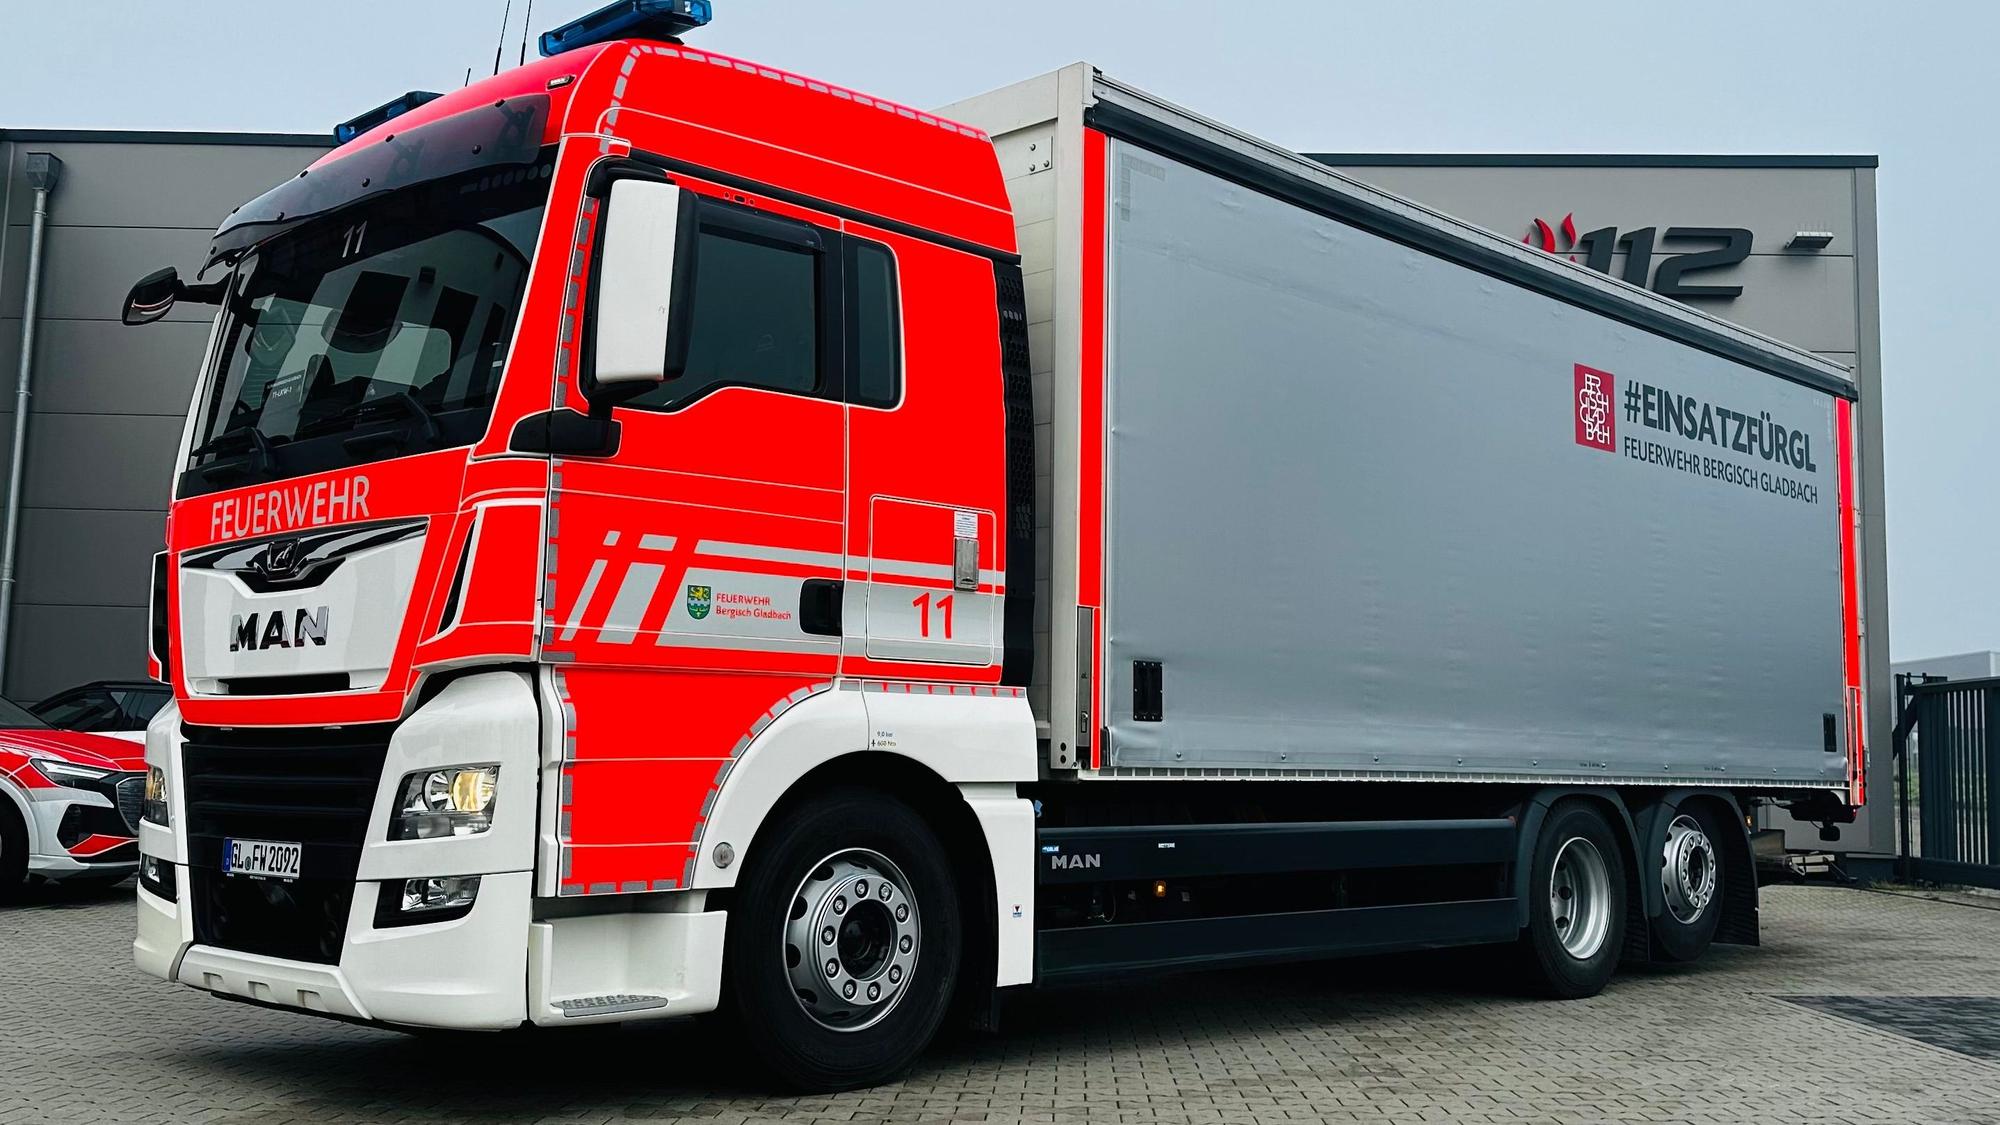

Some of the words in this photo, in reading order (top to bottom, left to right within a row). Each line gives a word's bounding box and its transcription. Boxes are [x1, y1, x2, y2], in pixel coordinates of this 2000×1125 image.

[342, 220, 367, 258] 11
[1580, 227, 1754, 298] 112
[1624, 380, 1817, 473] #EINSATZFÜRGL
[1624, 436, 1701, 475] FEUERWEHR
[1703, 456, 1759, 489] BERGISCH
[1760, 471, 1818, 504] GLADBACH
[211, 475, 370, 541] FEUERWEHR
[716, 593, 771, 606] FEUERWEHR
[716, 605, 752, 619] Bergisch
[753, 608, 792, 620] Gladbach
[912, 591, 954, 640] 11
[229, 605, 330, 652] MAN
[231, 843, 243, 868] GL
[252, 845, 267, 871] FW
[268, 846, 299, 873] 2092
[1051, 854, 1101, 870] MAN
